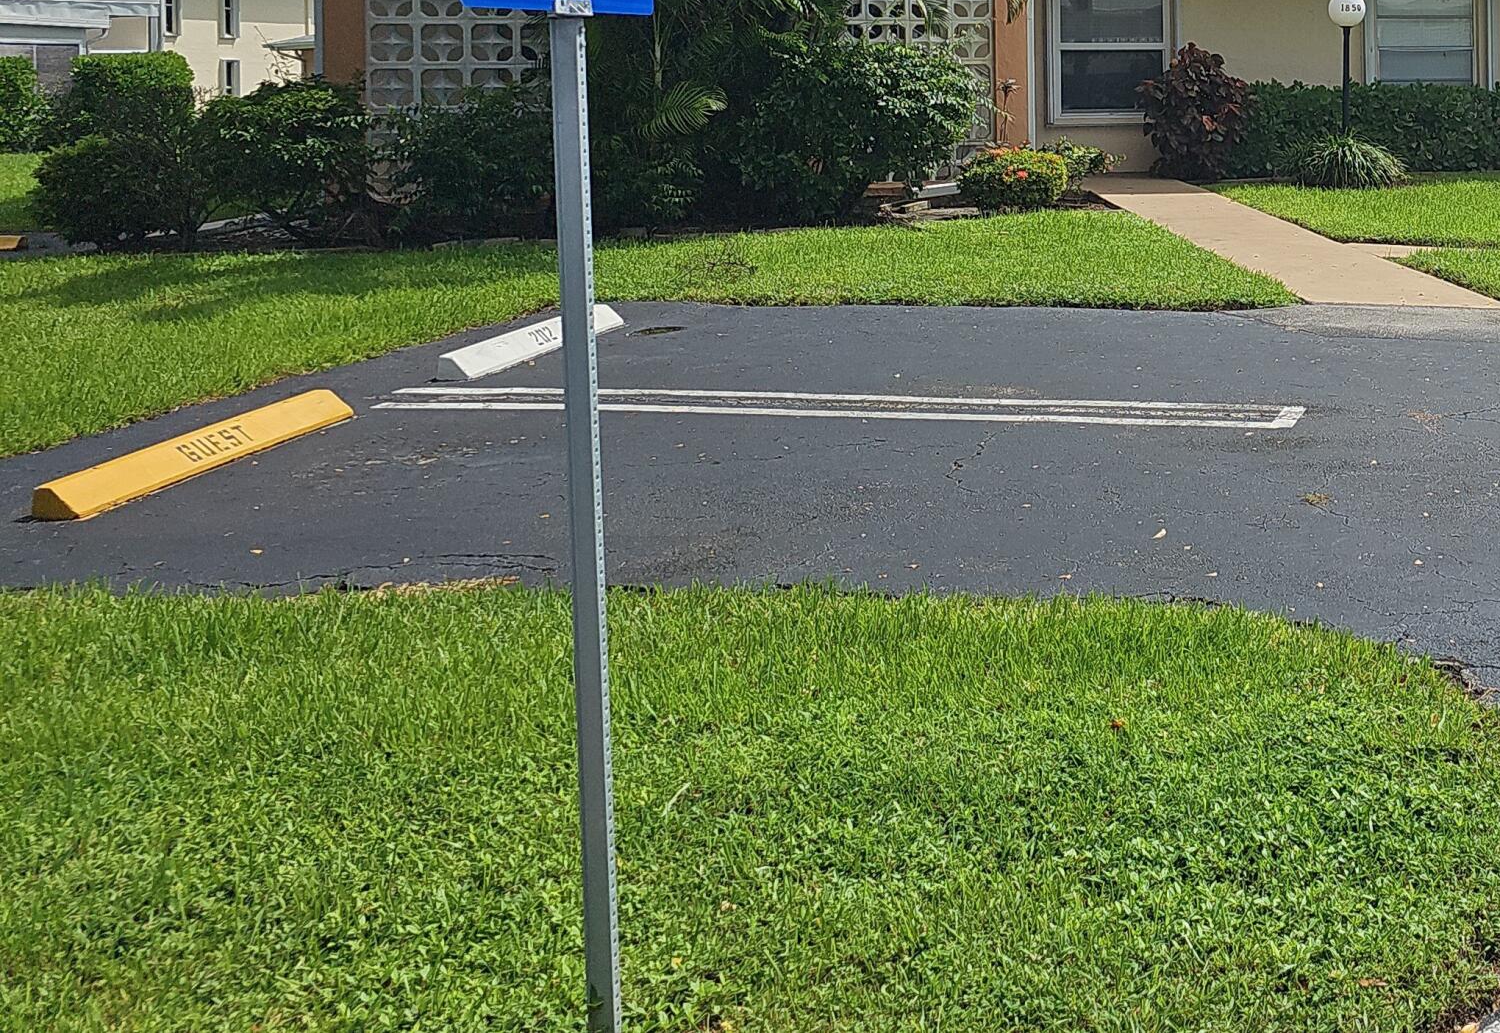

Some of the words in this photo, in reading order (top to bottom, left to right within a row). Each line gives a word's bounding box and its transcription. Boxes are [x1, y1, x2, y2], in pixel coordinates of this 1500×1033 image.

[1341, 3, 1362, 12] 1850
[527, 326, 559, 346] 202
[175, 425, 255, 463] GUEST
